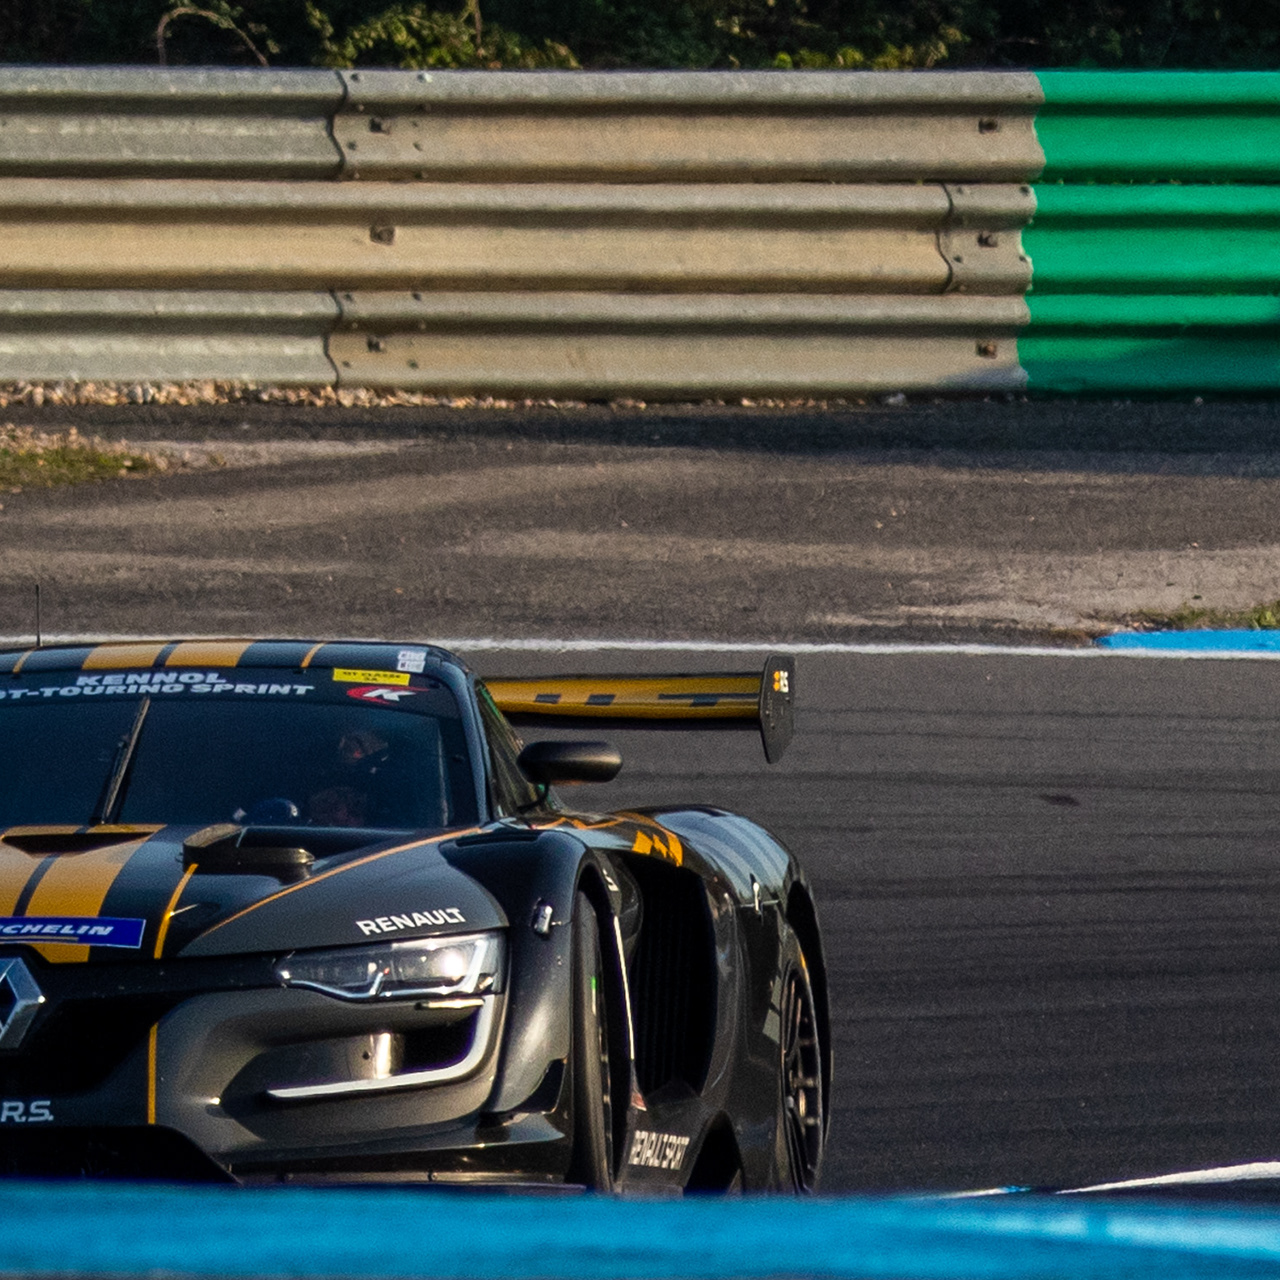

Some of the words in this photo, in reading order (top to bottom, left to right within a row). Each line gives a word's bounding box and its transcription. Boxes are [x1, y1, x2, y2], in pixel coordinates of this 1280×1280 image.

[76, 672, 227, 686] KENNOL
[190, 684, 315, 695] SPRINT
[356, 907, 466, 936] RENAULT
[0, 1100, 54, 1122] R.S.
